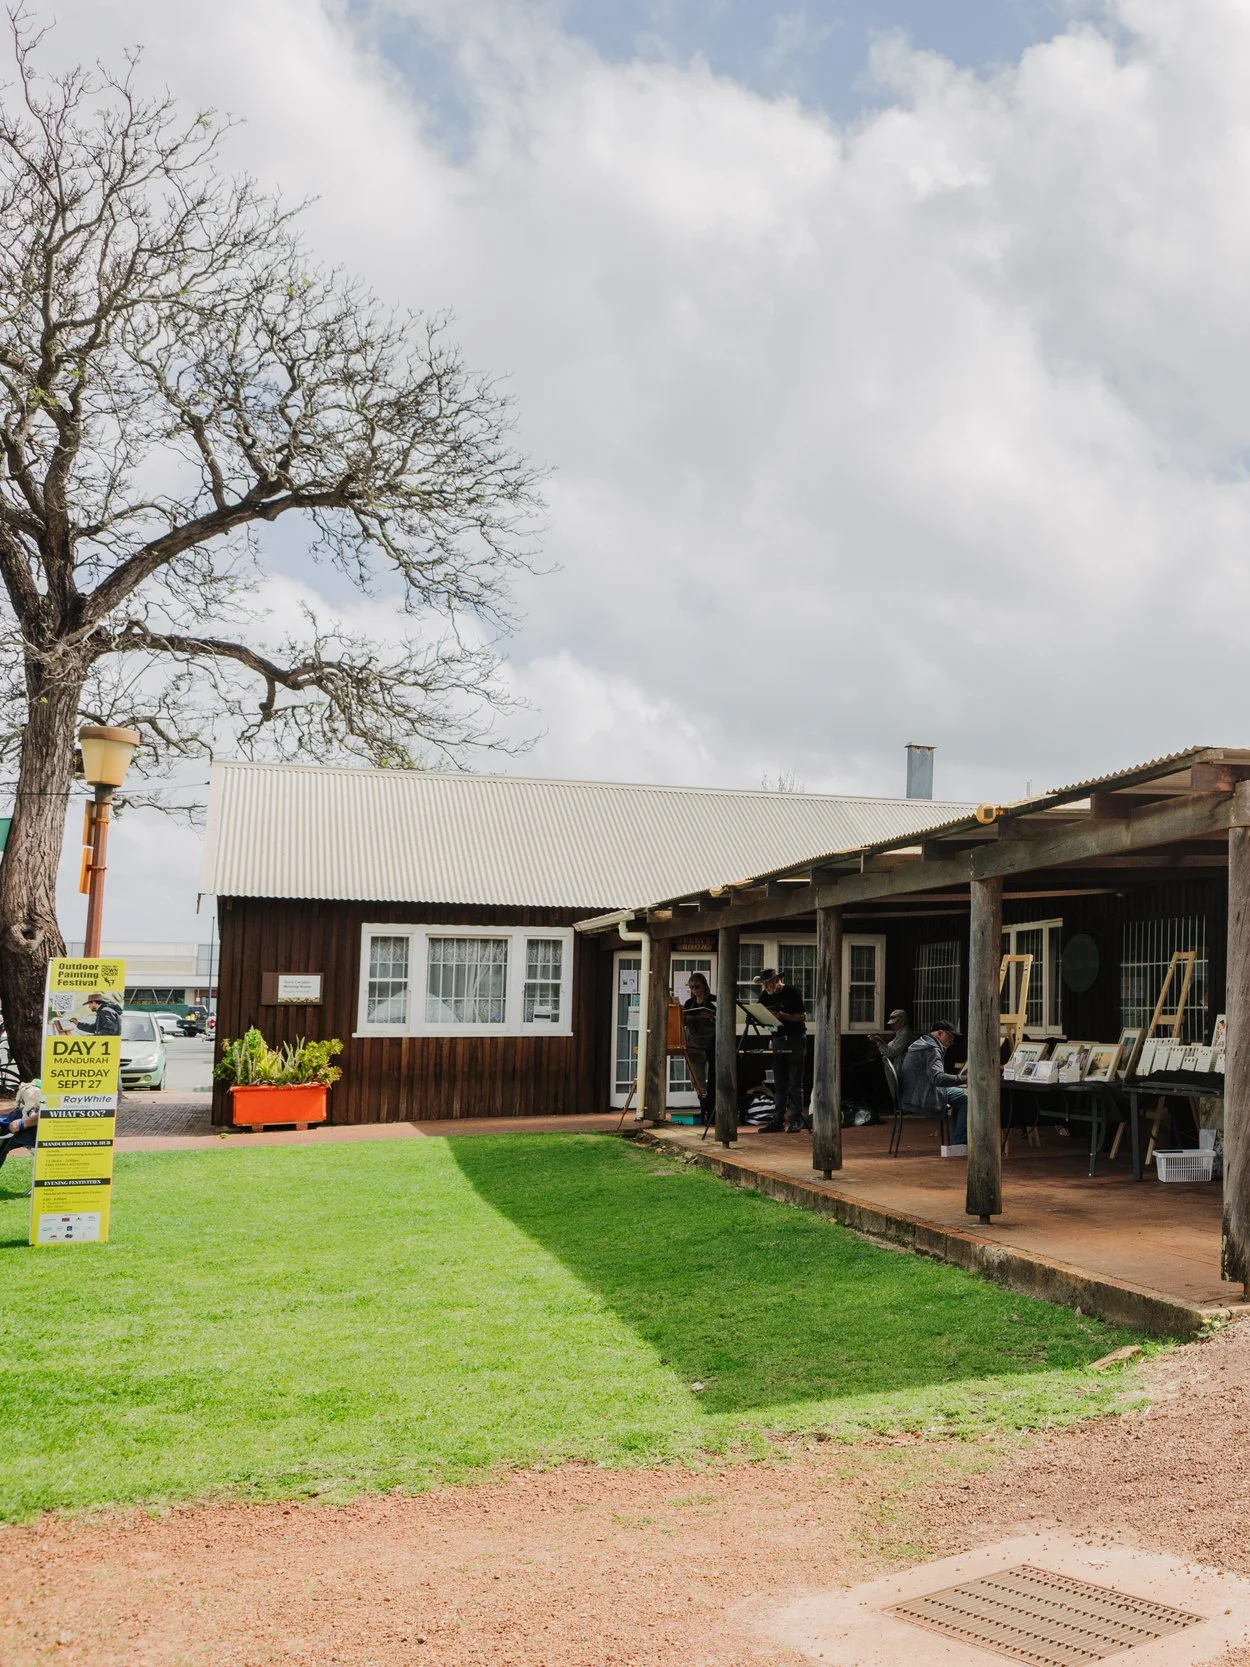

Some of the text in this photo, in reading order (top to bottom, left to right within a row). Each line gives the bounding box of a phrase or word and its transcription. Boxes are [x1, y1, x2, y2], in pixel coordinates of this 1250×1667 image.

[58, 971, 99, 979] Painting
[53, 1041, 111, 1055] DAY 1
[50, 1069, 110, 1078] SATURDAY
[58, 1080, 102, 1088] SEPT 27
[49, 1110, 85, 1118] WHAT'S
